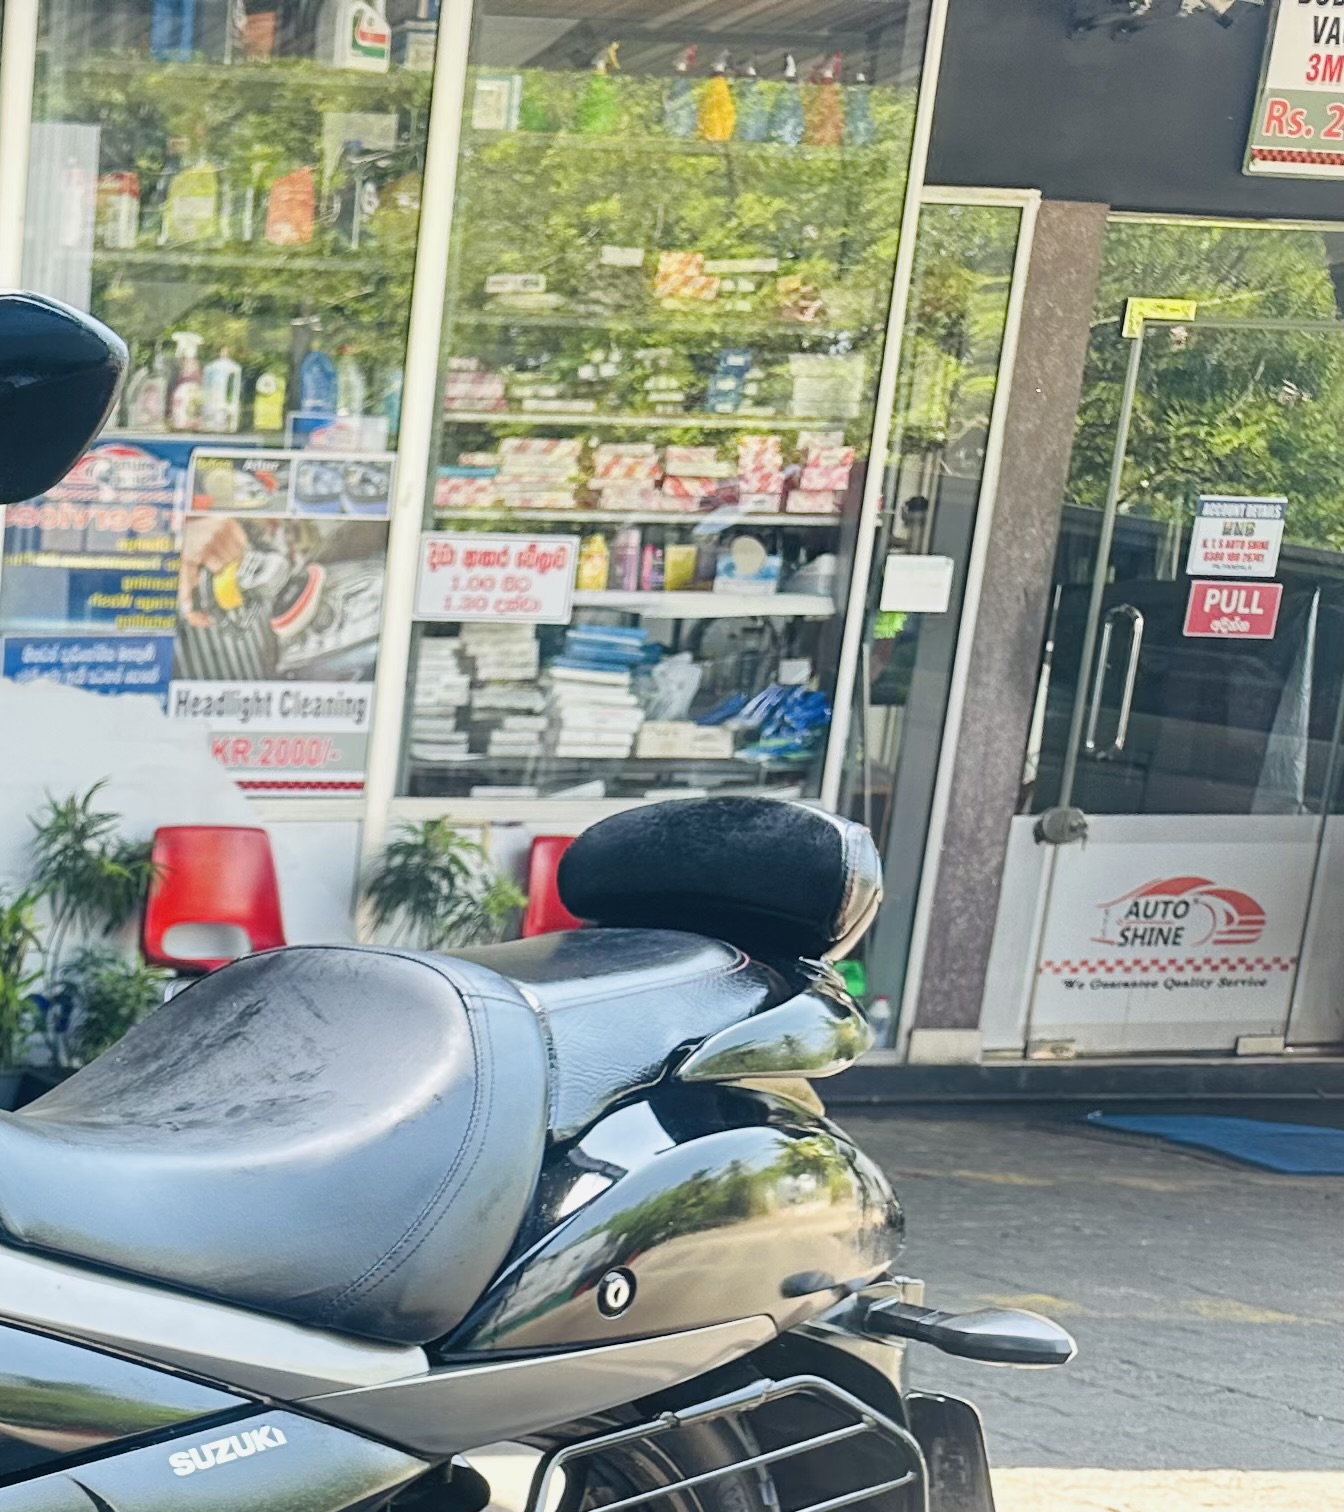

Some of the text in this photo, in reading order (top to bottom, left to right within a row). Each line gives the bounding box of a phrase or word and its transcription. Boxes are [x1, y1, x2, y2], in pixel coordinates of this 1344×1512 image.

[1313, 15, 1344, 45] VA
[1262, 98, 1314, 138] Rs.
[1203, 588, 1264, 615] PULL
[175, 689, 368, 725] Headlight Cleaning
[1124, 900, 1190, 920] AUTO
[1117, 927, 1185, 947] SHINE
[168, 1425, 289, 1477] SUZUKI
